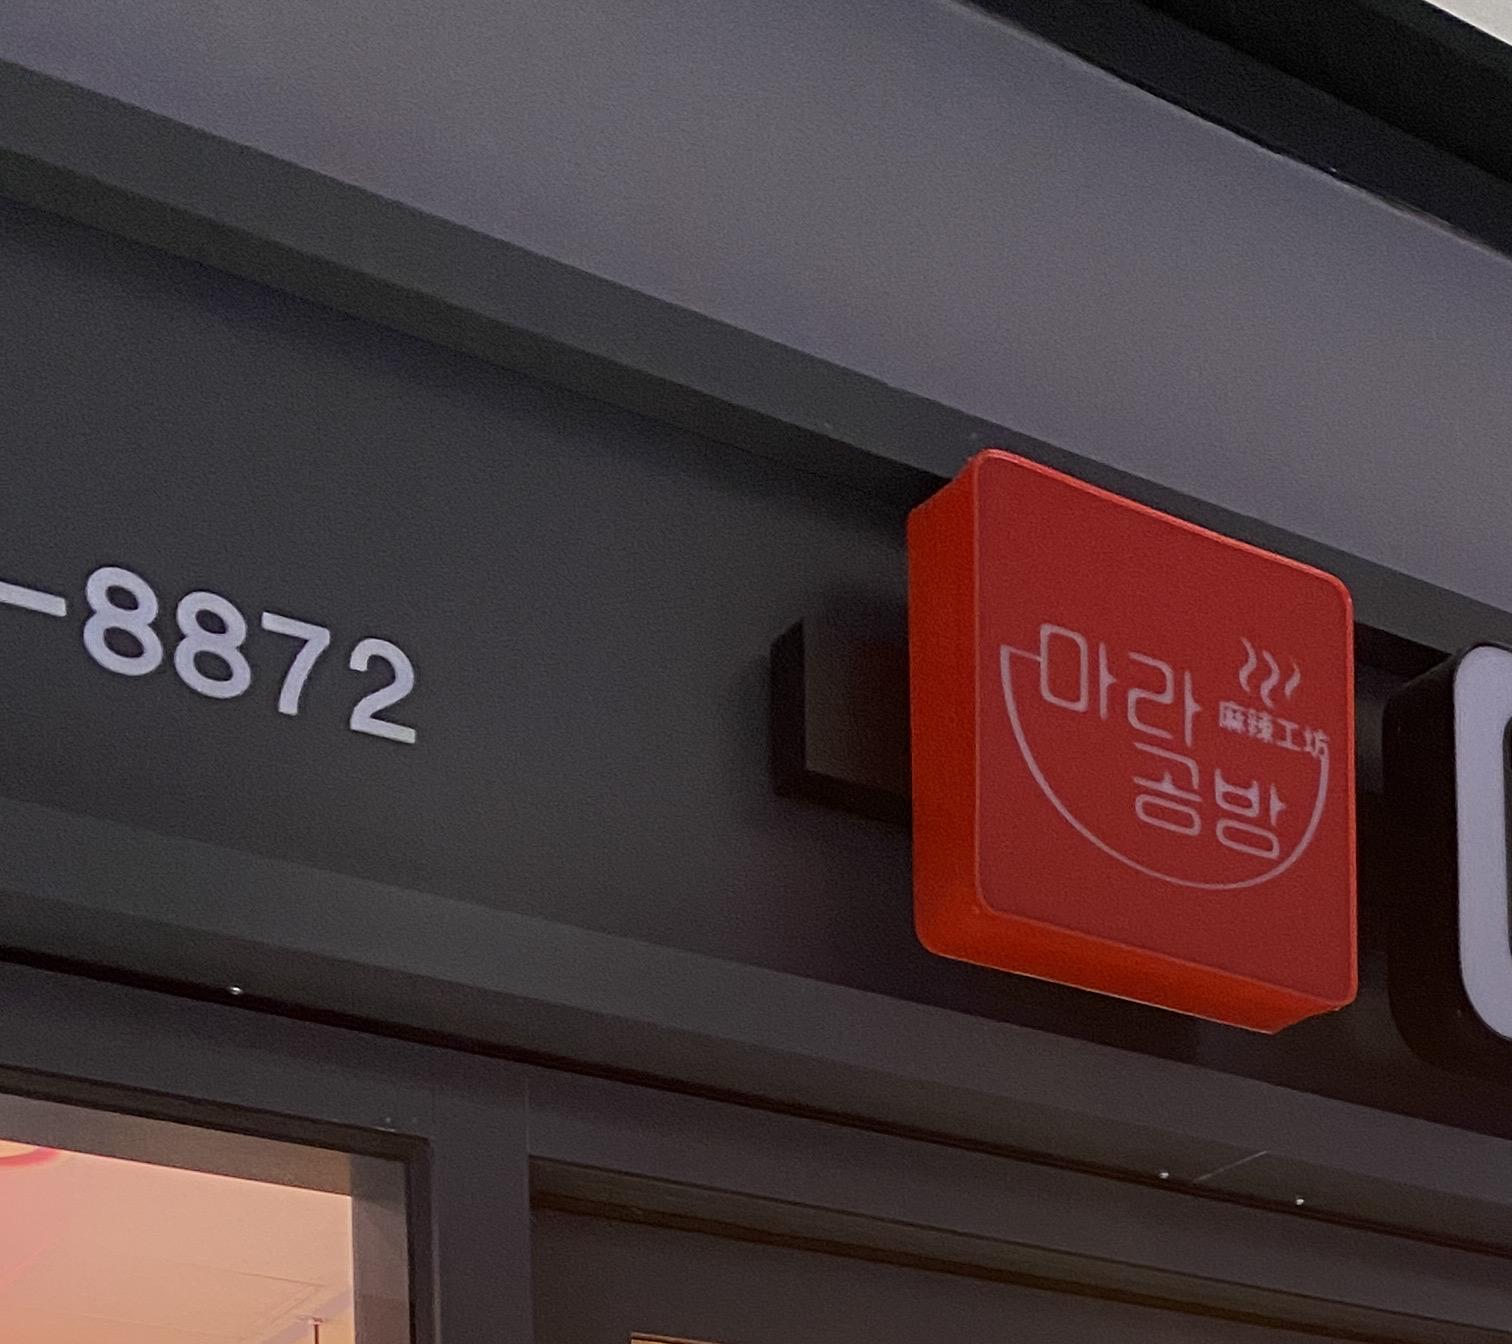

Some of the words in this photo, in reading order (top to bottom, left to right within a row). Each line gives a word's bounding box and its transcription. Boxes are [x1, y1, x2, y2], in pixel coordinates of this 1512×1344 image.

[1039, 622, 1203, 749] 마라
[1217, 700, 1330, 759] 麻辣工坊
[1131, 741, 1288, 859] 공방
